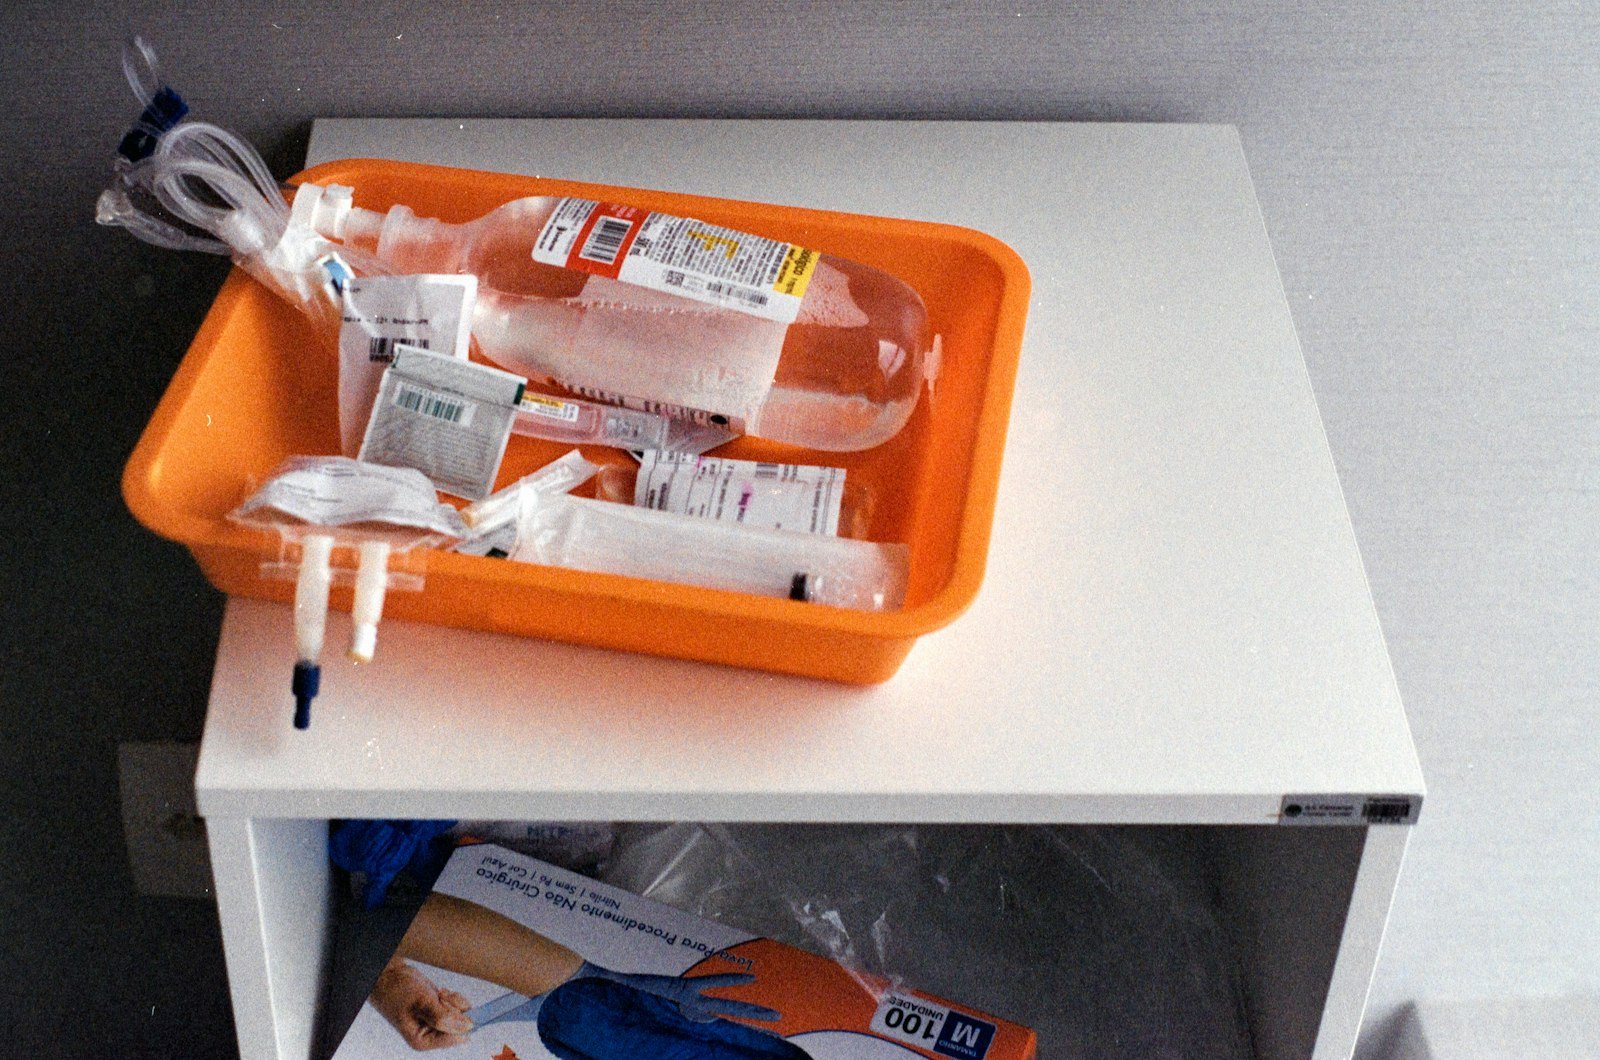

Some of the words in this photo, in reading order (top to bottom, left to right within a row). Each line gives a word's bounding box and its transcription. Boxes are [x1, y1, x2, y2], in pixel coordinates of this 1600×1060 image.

[481, 855, 507, 872] Azul
[508, 865, 527, 877] Cor
[476, 866, 540, 899] Cirúrgico
[539, 875, 552, 886] Pó
[554, 880, 577, 894] Sem
[544, 891, 577, 912] Não
[589, 892, 621, 910] Nitrilo
[580, 903, 678, 946] Procedimento
[681, 937, 716, 958] Para
[889, 997, 944, 1021] UNIDADES
[885, 1007, 934, 1039] 100
[951, 1021, 980, 1047] M
